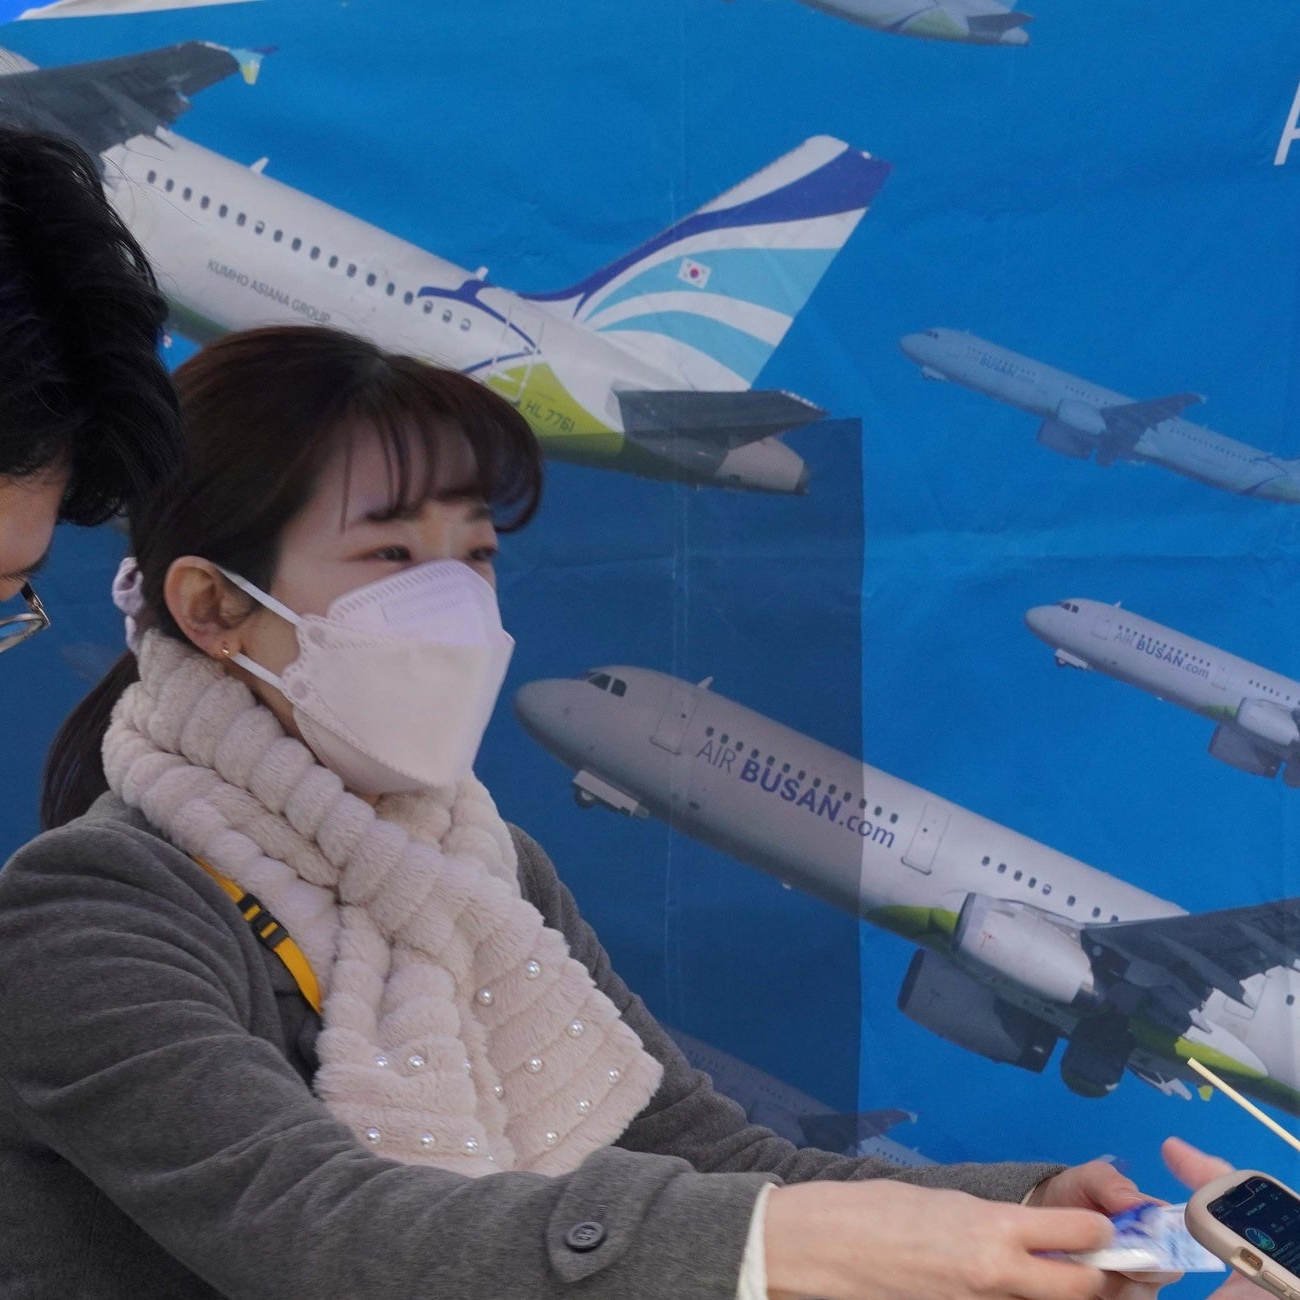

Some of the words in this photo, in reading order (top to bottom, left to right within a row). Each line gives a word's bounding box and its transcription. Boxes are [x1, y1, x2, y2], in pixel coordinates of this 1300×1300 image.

[207, 259, 249, 287] KUMHO
[249, 279, 291, 306] ASIANA
[291, 298, 332, 323] GROUP
[696, 739, 738, 775] AIR
[739, 758, 896, 850] BUSAN.com
